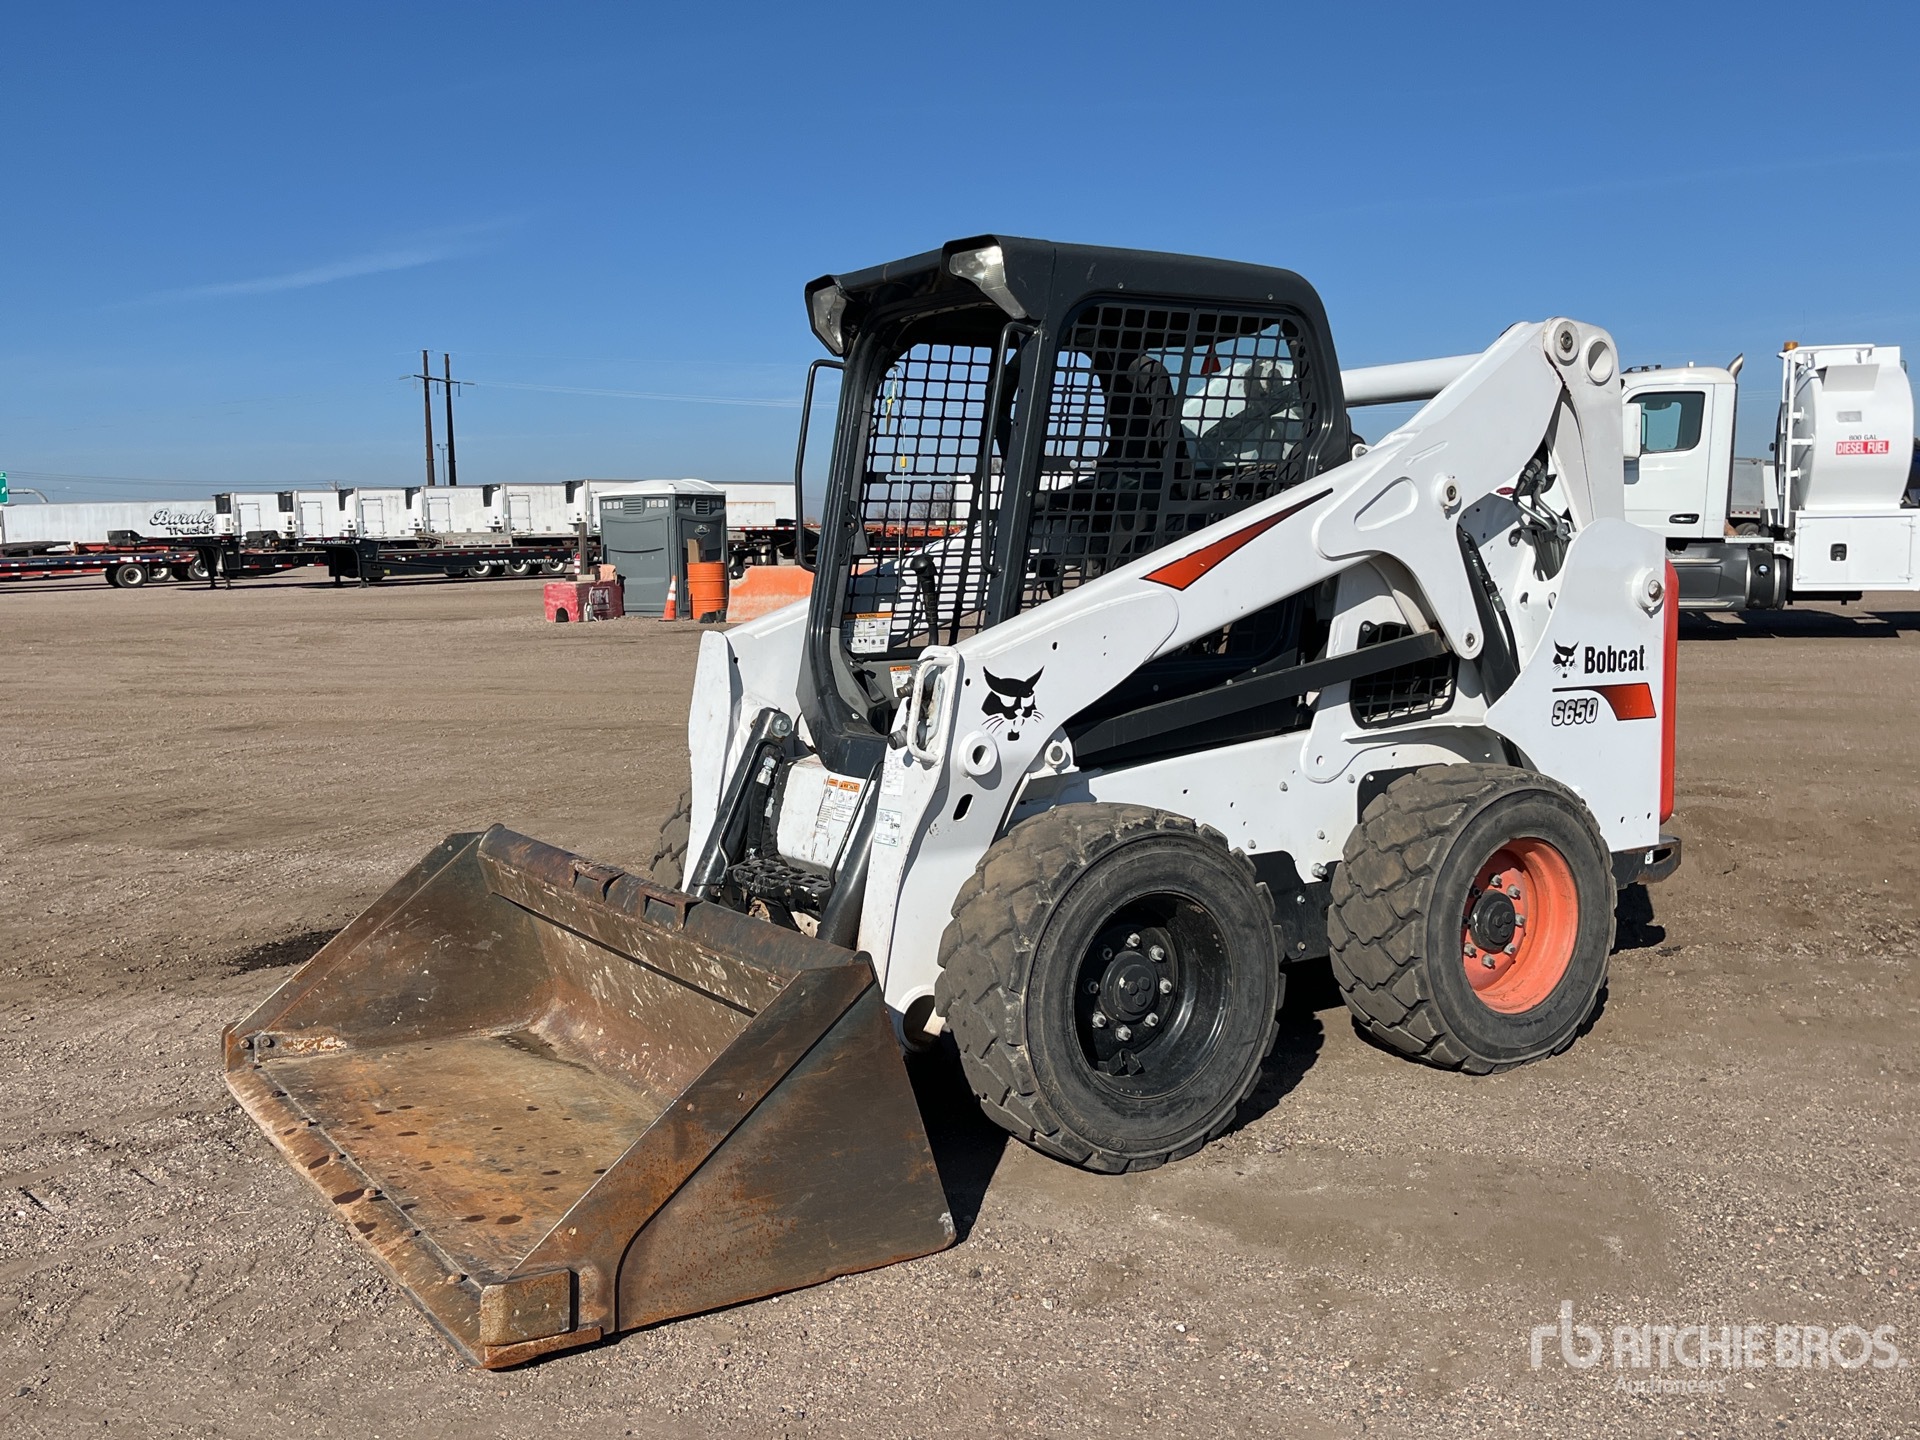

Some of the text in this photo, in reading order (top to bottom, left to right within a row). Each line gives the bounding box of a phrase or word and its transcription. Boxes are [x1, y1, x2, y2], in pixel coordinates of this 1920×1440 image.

[1836, 441, 1887, 454] DIESEL FUEL
[1584, 645, 1645, 674] Bobcat
[1552, 697, 1599, 727] S650
